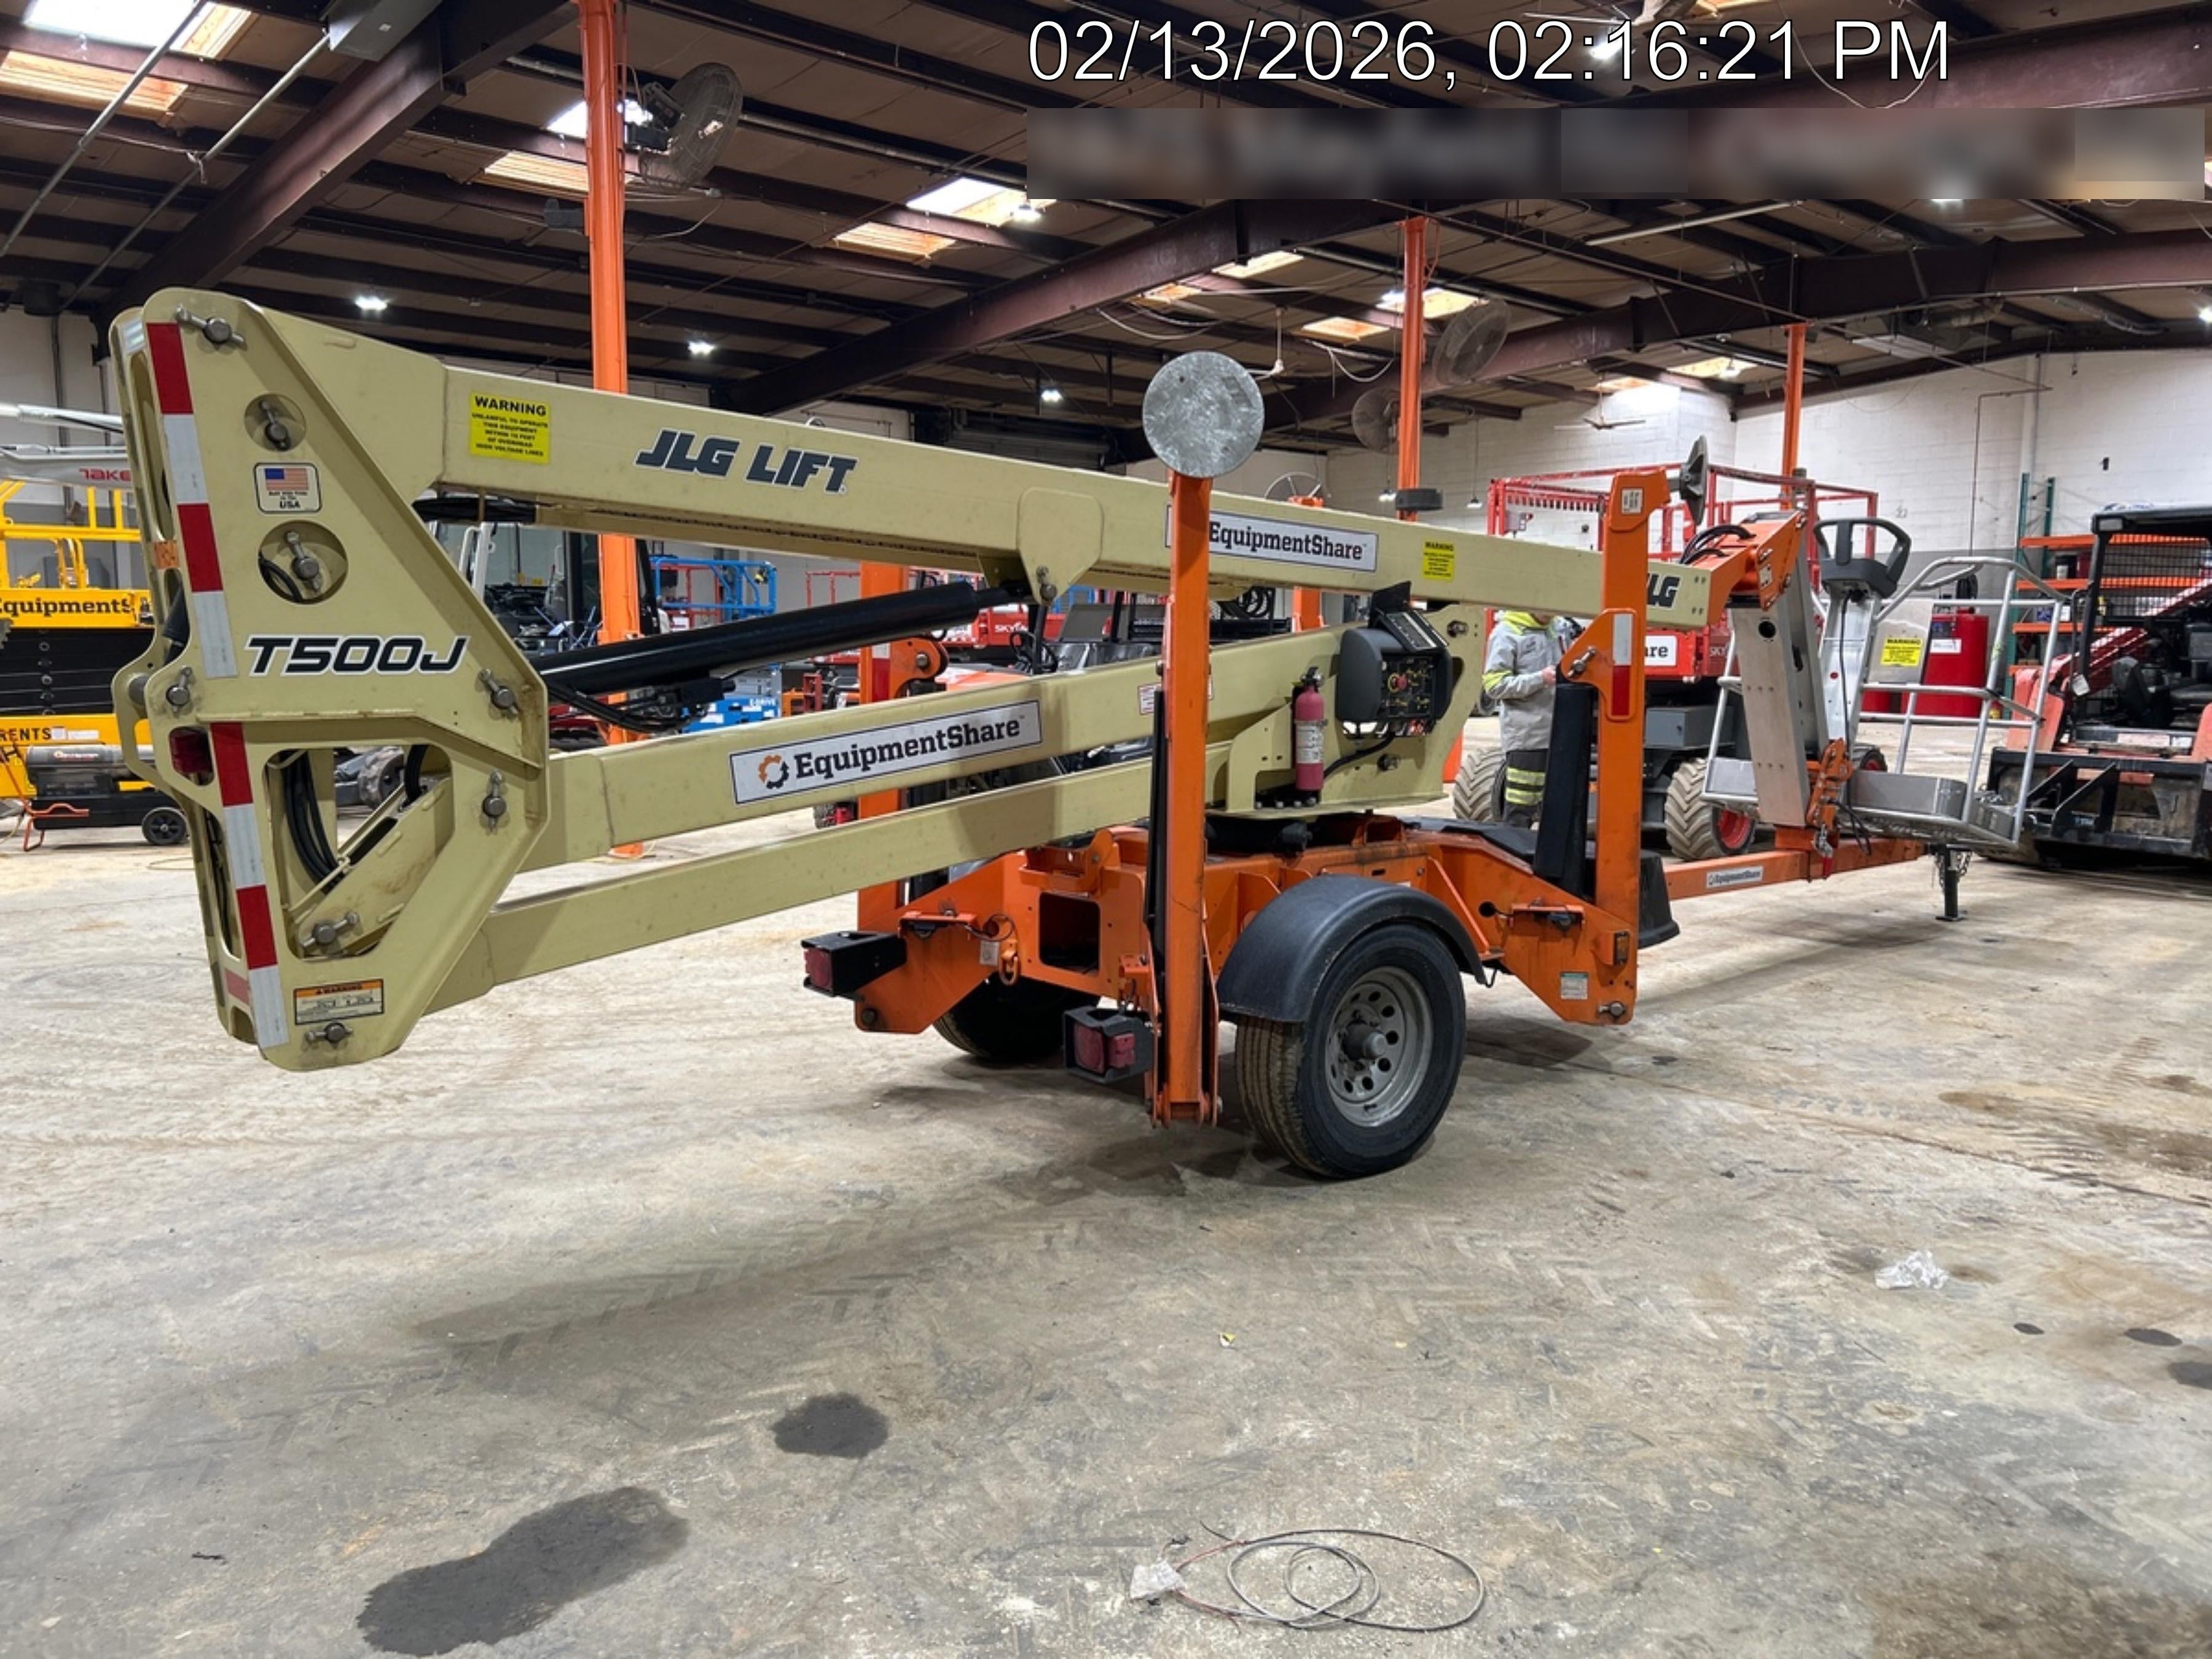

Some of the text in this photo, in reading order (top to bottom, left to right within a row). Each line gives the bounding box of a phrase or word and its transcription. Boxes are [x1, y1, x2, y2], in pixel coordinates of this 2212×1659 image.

[474, 395, 547, 417] WARNING
[635, 429, 858, 493] JLG LIFT
[280, 500, 301, 509] USA
[1209, 521, 1363, 560] EquipmentShare
[1647, 573, 1681, 608] LG
[247, 637, 469, 674] T500J
[793, 718, 1021, 779] EquipmentShare
